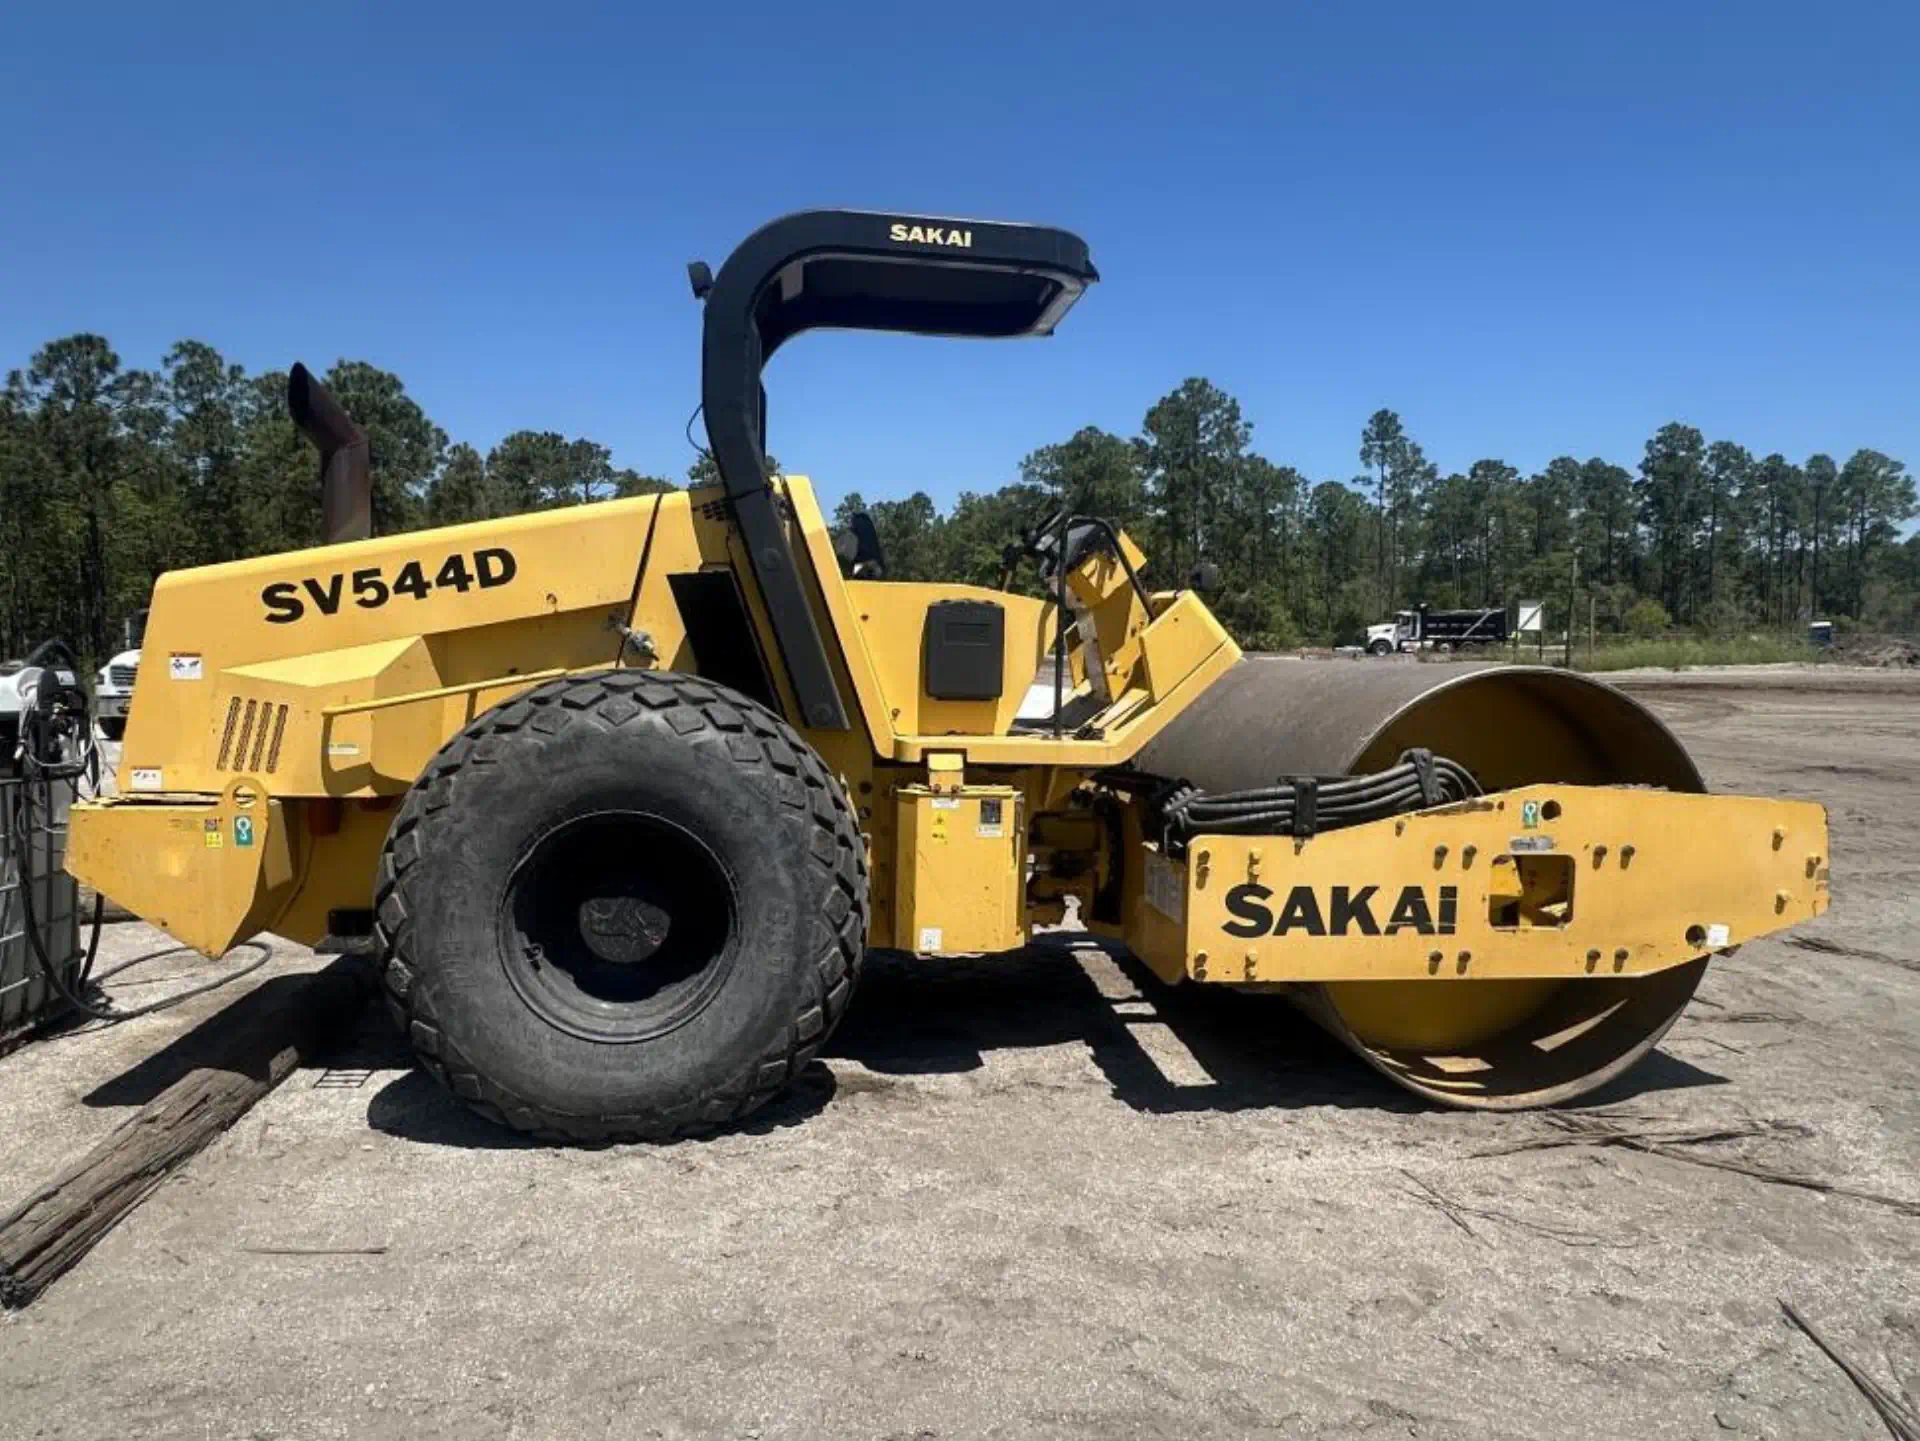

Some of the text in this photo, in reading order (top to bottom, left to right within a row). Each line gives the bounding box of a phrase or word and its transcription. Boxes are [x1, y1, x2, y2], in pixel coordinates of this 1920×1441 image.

[889, 223, 973, 249] SAKAI
[262, 548, 517, 625] SV544D
[1222, 881, 1459, 938] SAKAI
